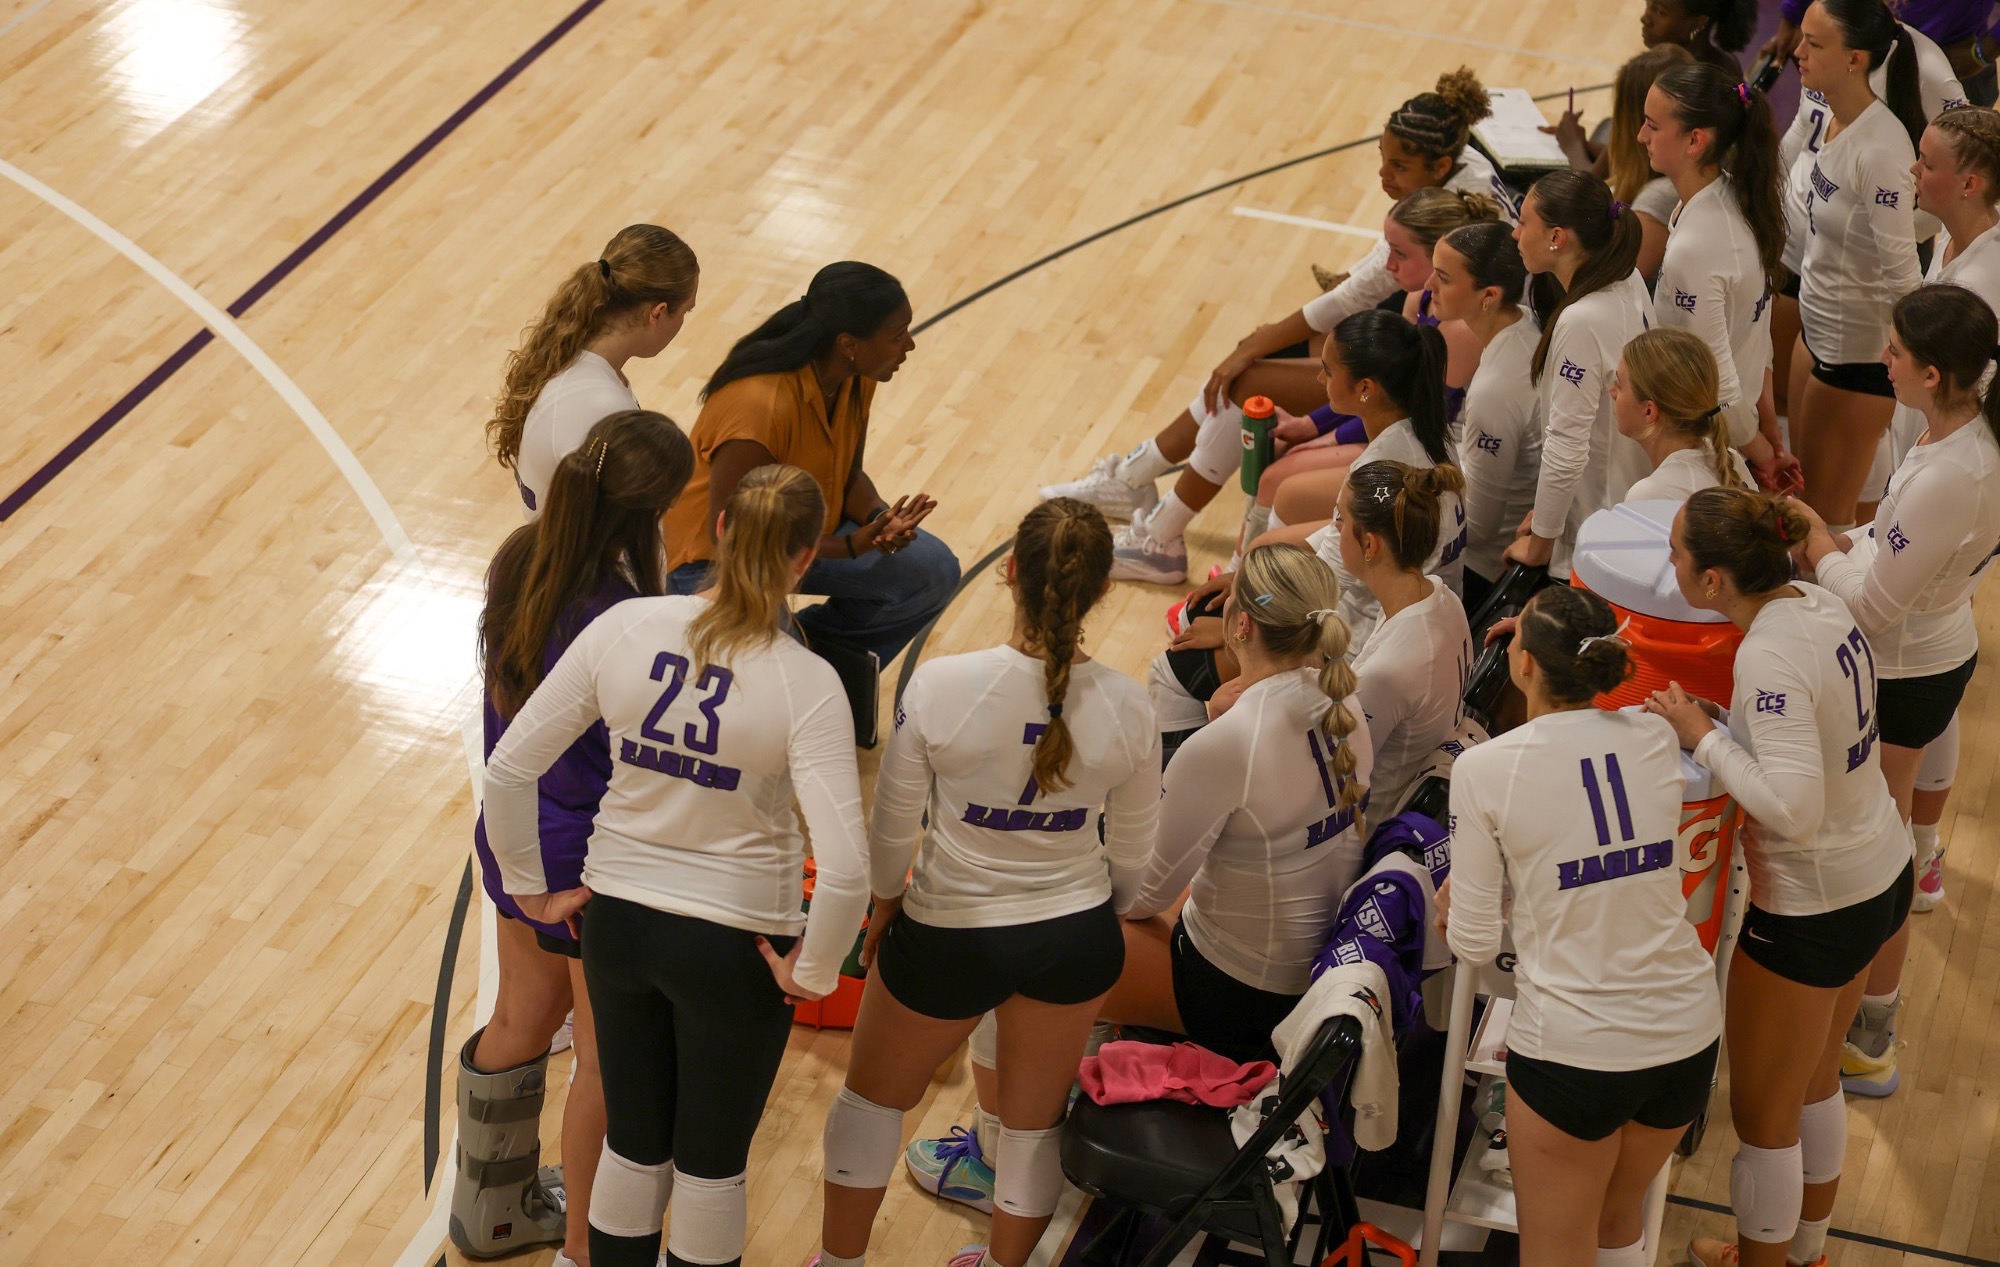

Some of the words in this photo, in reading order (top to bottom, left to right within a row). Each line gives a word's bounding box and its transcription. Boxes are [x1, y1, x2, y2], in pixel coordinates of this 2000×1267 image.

[1875, 191, 1899, 205] CCS
[1675, 294, 1697, 308] CCS
[1560, 364, 1586, 380] CCS
[1477, 437, 1502, 450] CCS
[1887, 527, 1911, 550] CCS
[1835, 625, 1875, 731] 27
[641, 651, 734, 755] 23
[1756, 693, 1786, 712] CCS
[620, 737, 742, 791] EAGLES
[1018, 722, 1048, 805] 7
[1580, 752, 1634, 846] 11
[960, 802, 1088, 832] EAGLES
[1557, 838, 1674, 891] EAGLES
